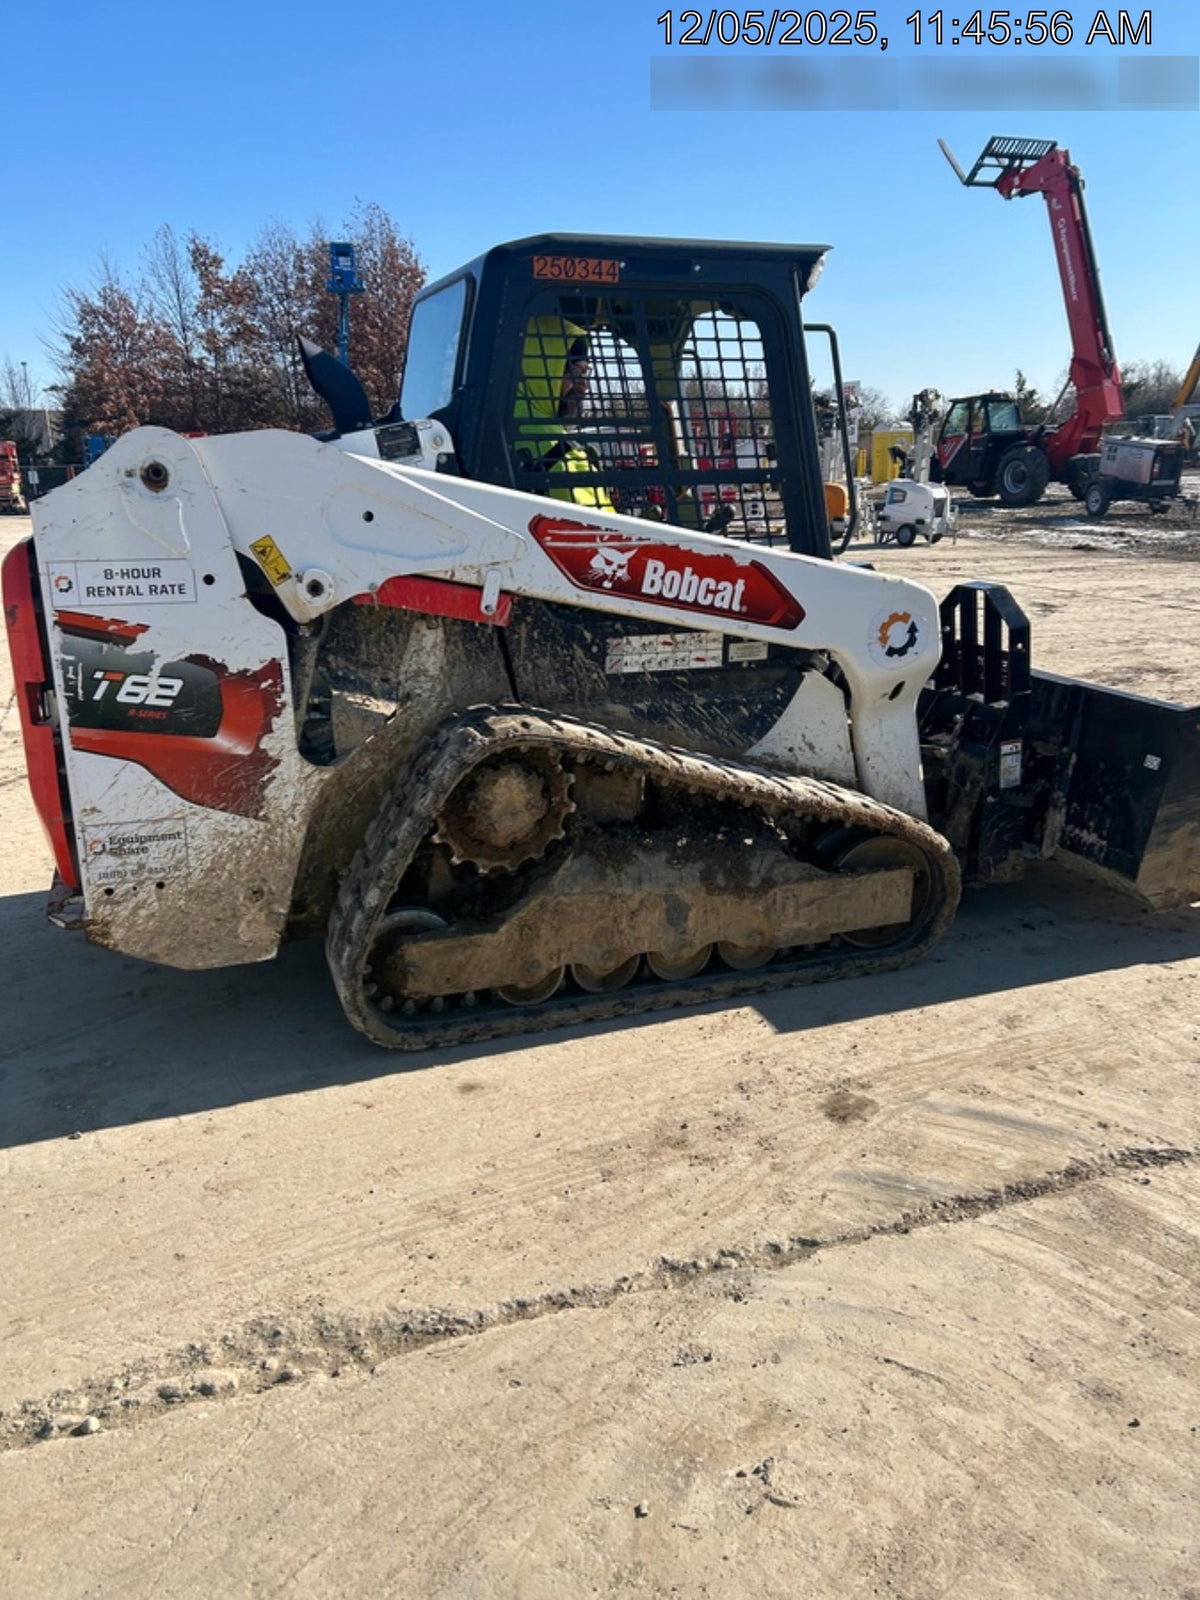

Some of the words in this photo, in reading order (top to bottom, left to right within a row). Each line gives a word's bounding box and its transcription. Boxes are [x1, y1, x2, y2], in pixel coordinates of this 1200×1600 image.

[535, 257, 617, 280] 250344
[103, 567, 162, 581] 8-HOUR
[86, 584, 144, 598] RENTAL
[149, 583, 187, 596] RATE
[641, 558, 746, 612] Bobcat
[92, 671, 184, 707] T62
[108, 831, 183, 846] Equipment
